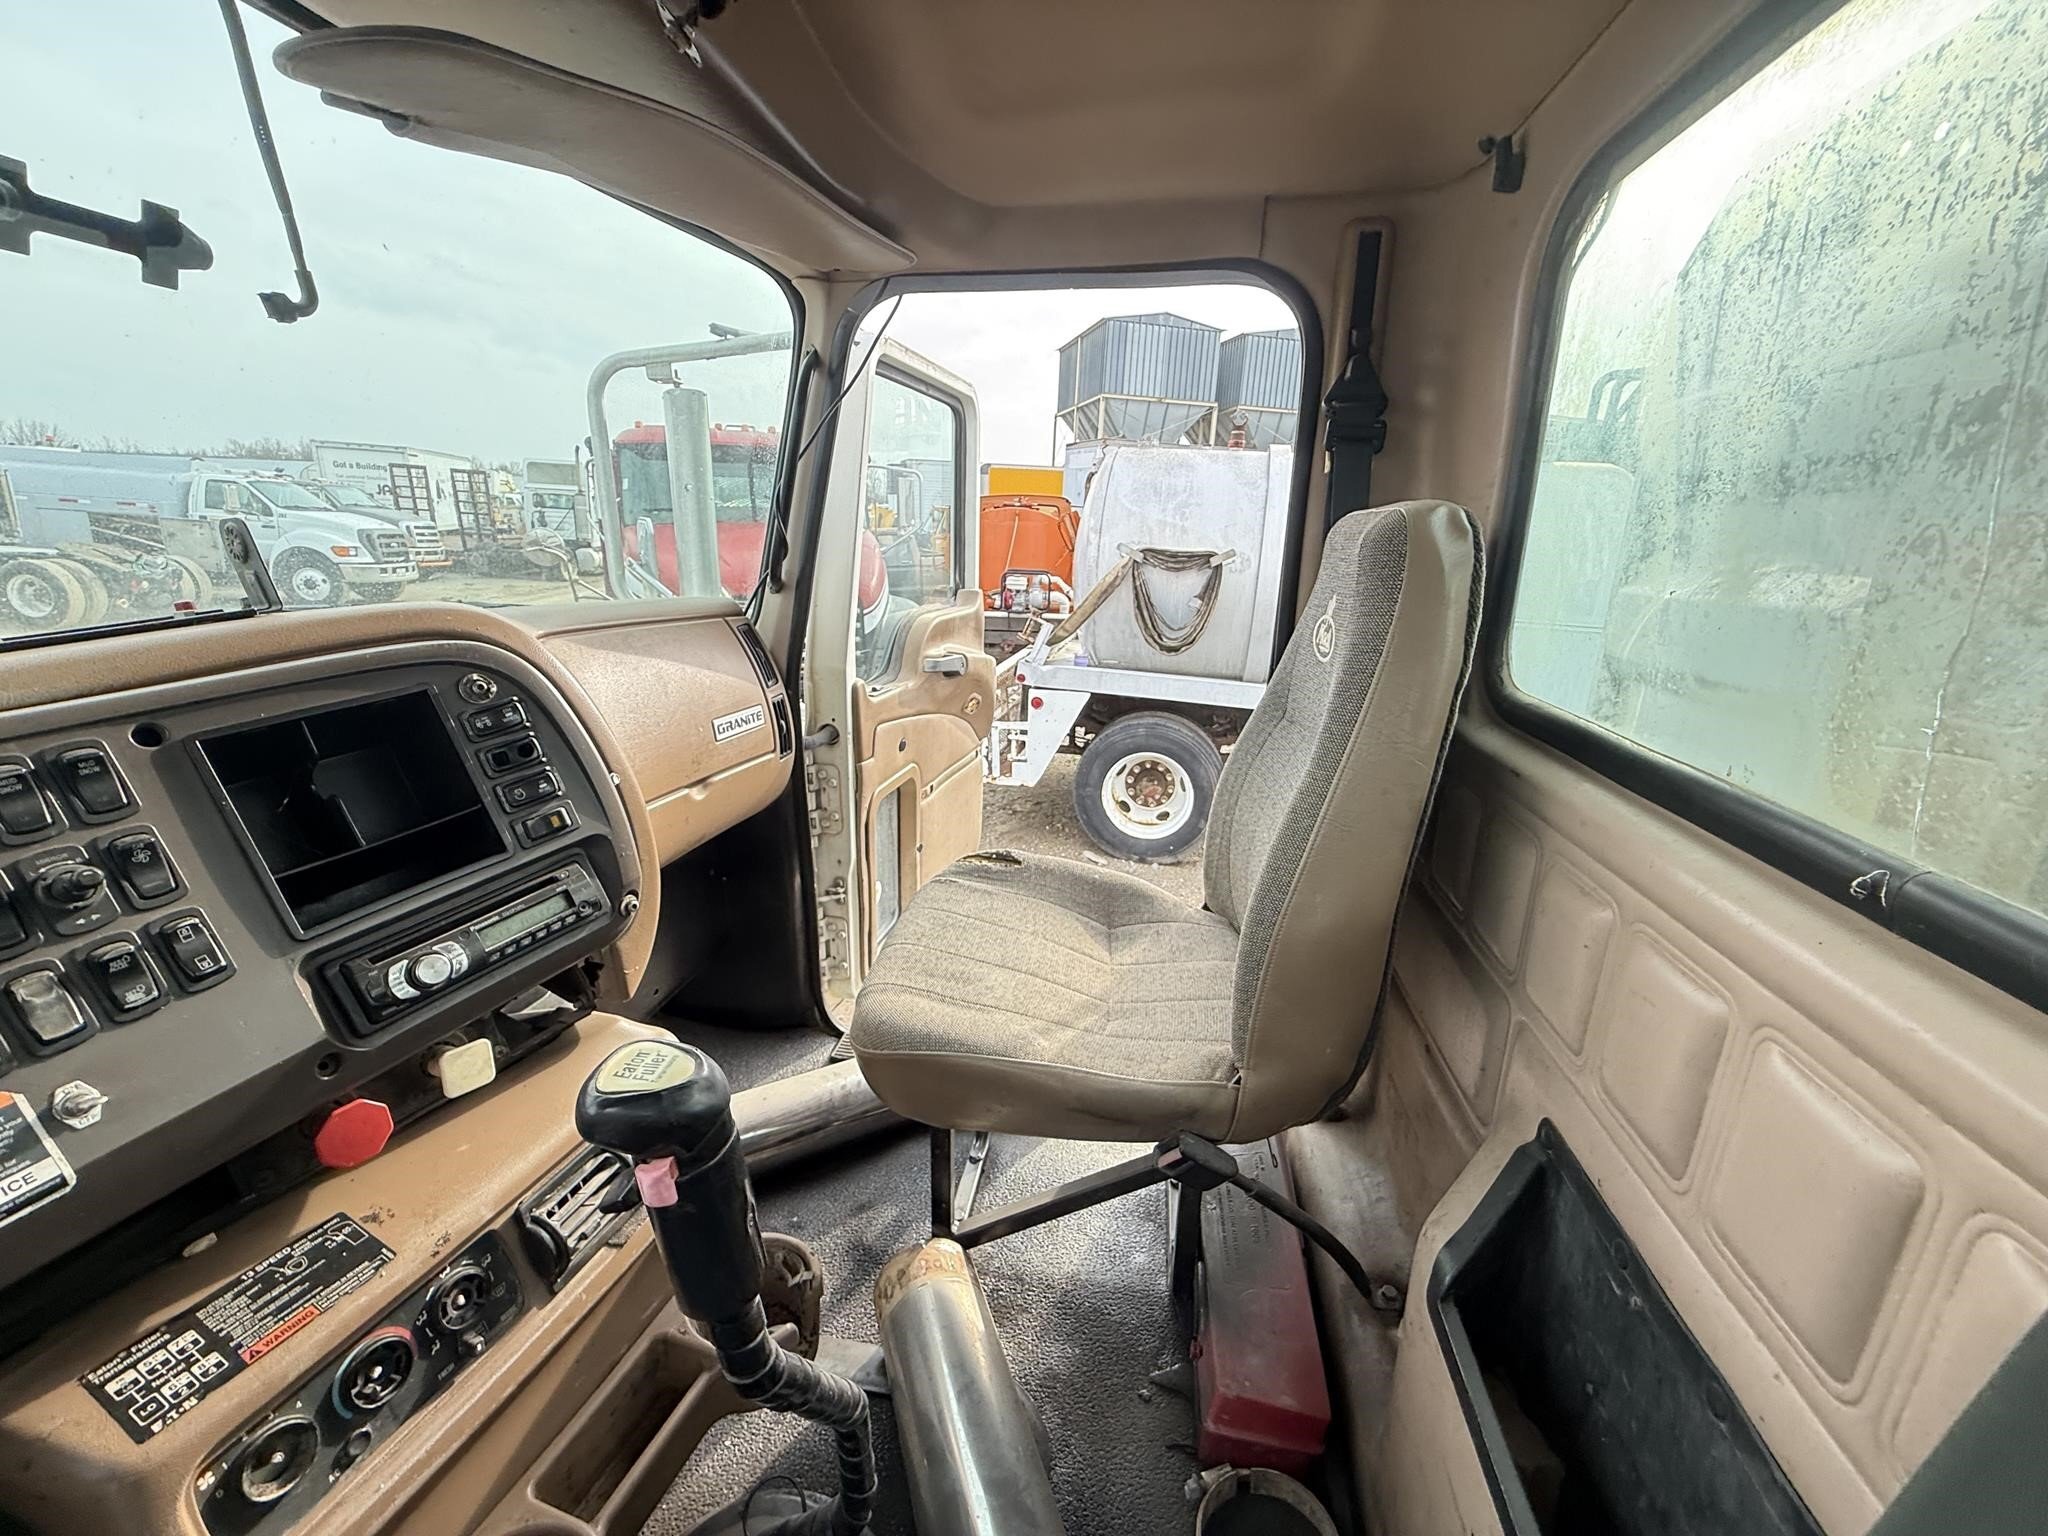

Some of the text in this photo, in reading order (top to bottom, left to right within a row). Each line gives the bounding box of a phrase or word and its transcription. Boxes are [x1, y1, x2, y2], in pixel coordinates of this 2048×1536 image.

[333, 460, 347, 469] Got
[356, 462, 388, 472] Building
[717, 711, 762, 735] GRANITE
[78, 760, 95, 768] MUD
[79, 767, 100, 776] SNOW
[613, 1049, 651, 1079] Eaton
[632, 1050, 669, 1082] Fuller
[240, 1246, 292, 1281] 13 SPEED
[262, 1309, 315, 1348] WARNING
[86, 1330, 161, 1380] Eaton Fuller
[182, 1341, 195, 1352] 3
[91, 1332, 171, 1386] Transmissions
[152, 1363, 162, 1372] 1
[150, 1361, 186, 1388] Neutral
[205, 1364, 218, 1376] 4
[177, 1384, 190, 1396] 2
[138, 1401, 157, 1417] LO
